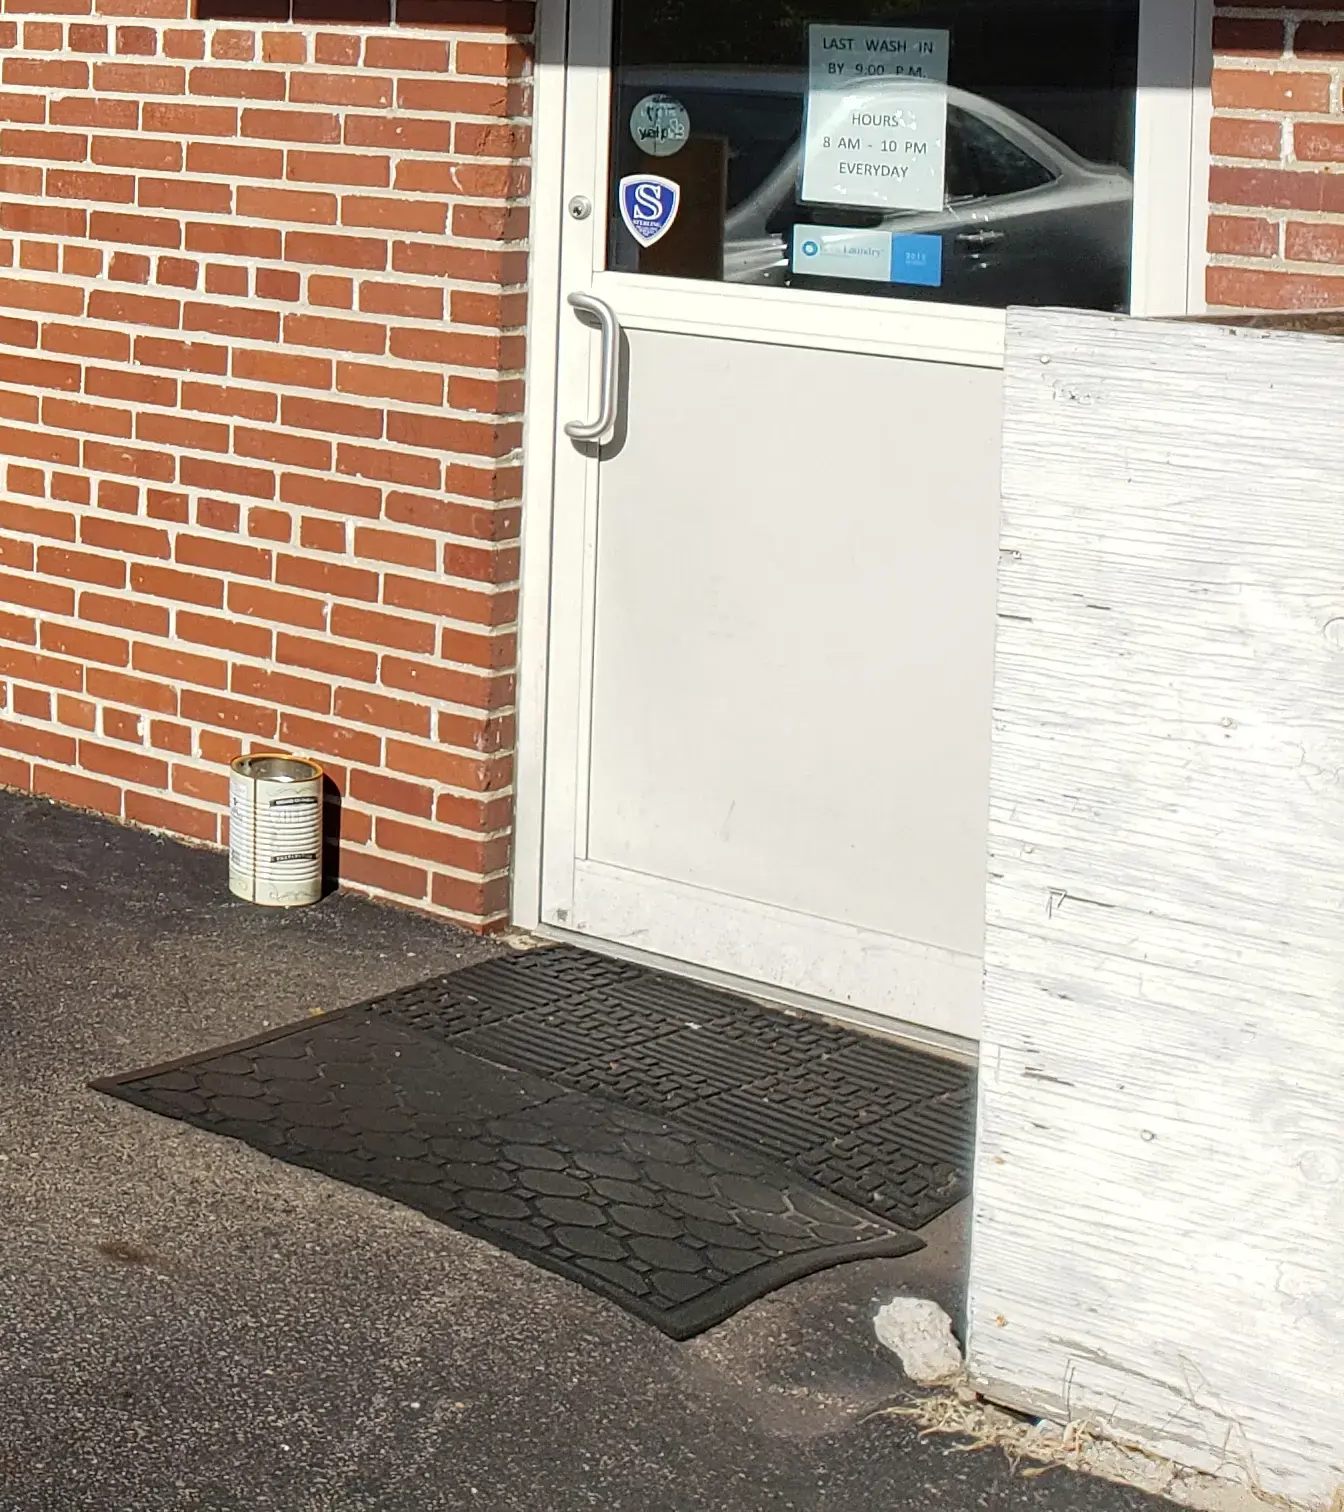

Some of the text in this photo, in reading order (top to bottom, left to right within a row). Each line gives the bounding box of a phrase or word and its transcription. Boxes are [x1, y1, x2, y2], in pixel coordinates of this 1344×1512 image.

[823, 37, 933, 54] LAST WASH IN
[828, 62, 927, 78] BY 9:00 PM.
[852, 113, 899, 127] HOURS
[823, 136, 831, 148] 8
[838, 137, 861, 150] AM
[881, 140, 897, 152] 10
[905, 141, 927, 154] PM
[839, 162, 909, 178] EVERYDAY
[633, 184, 663, 220] S
